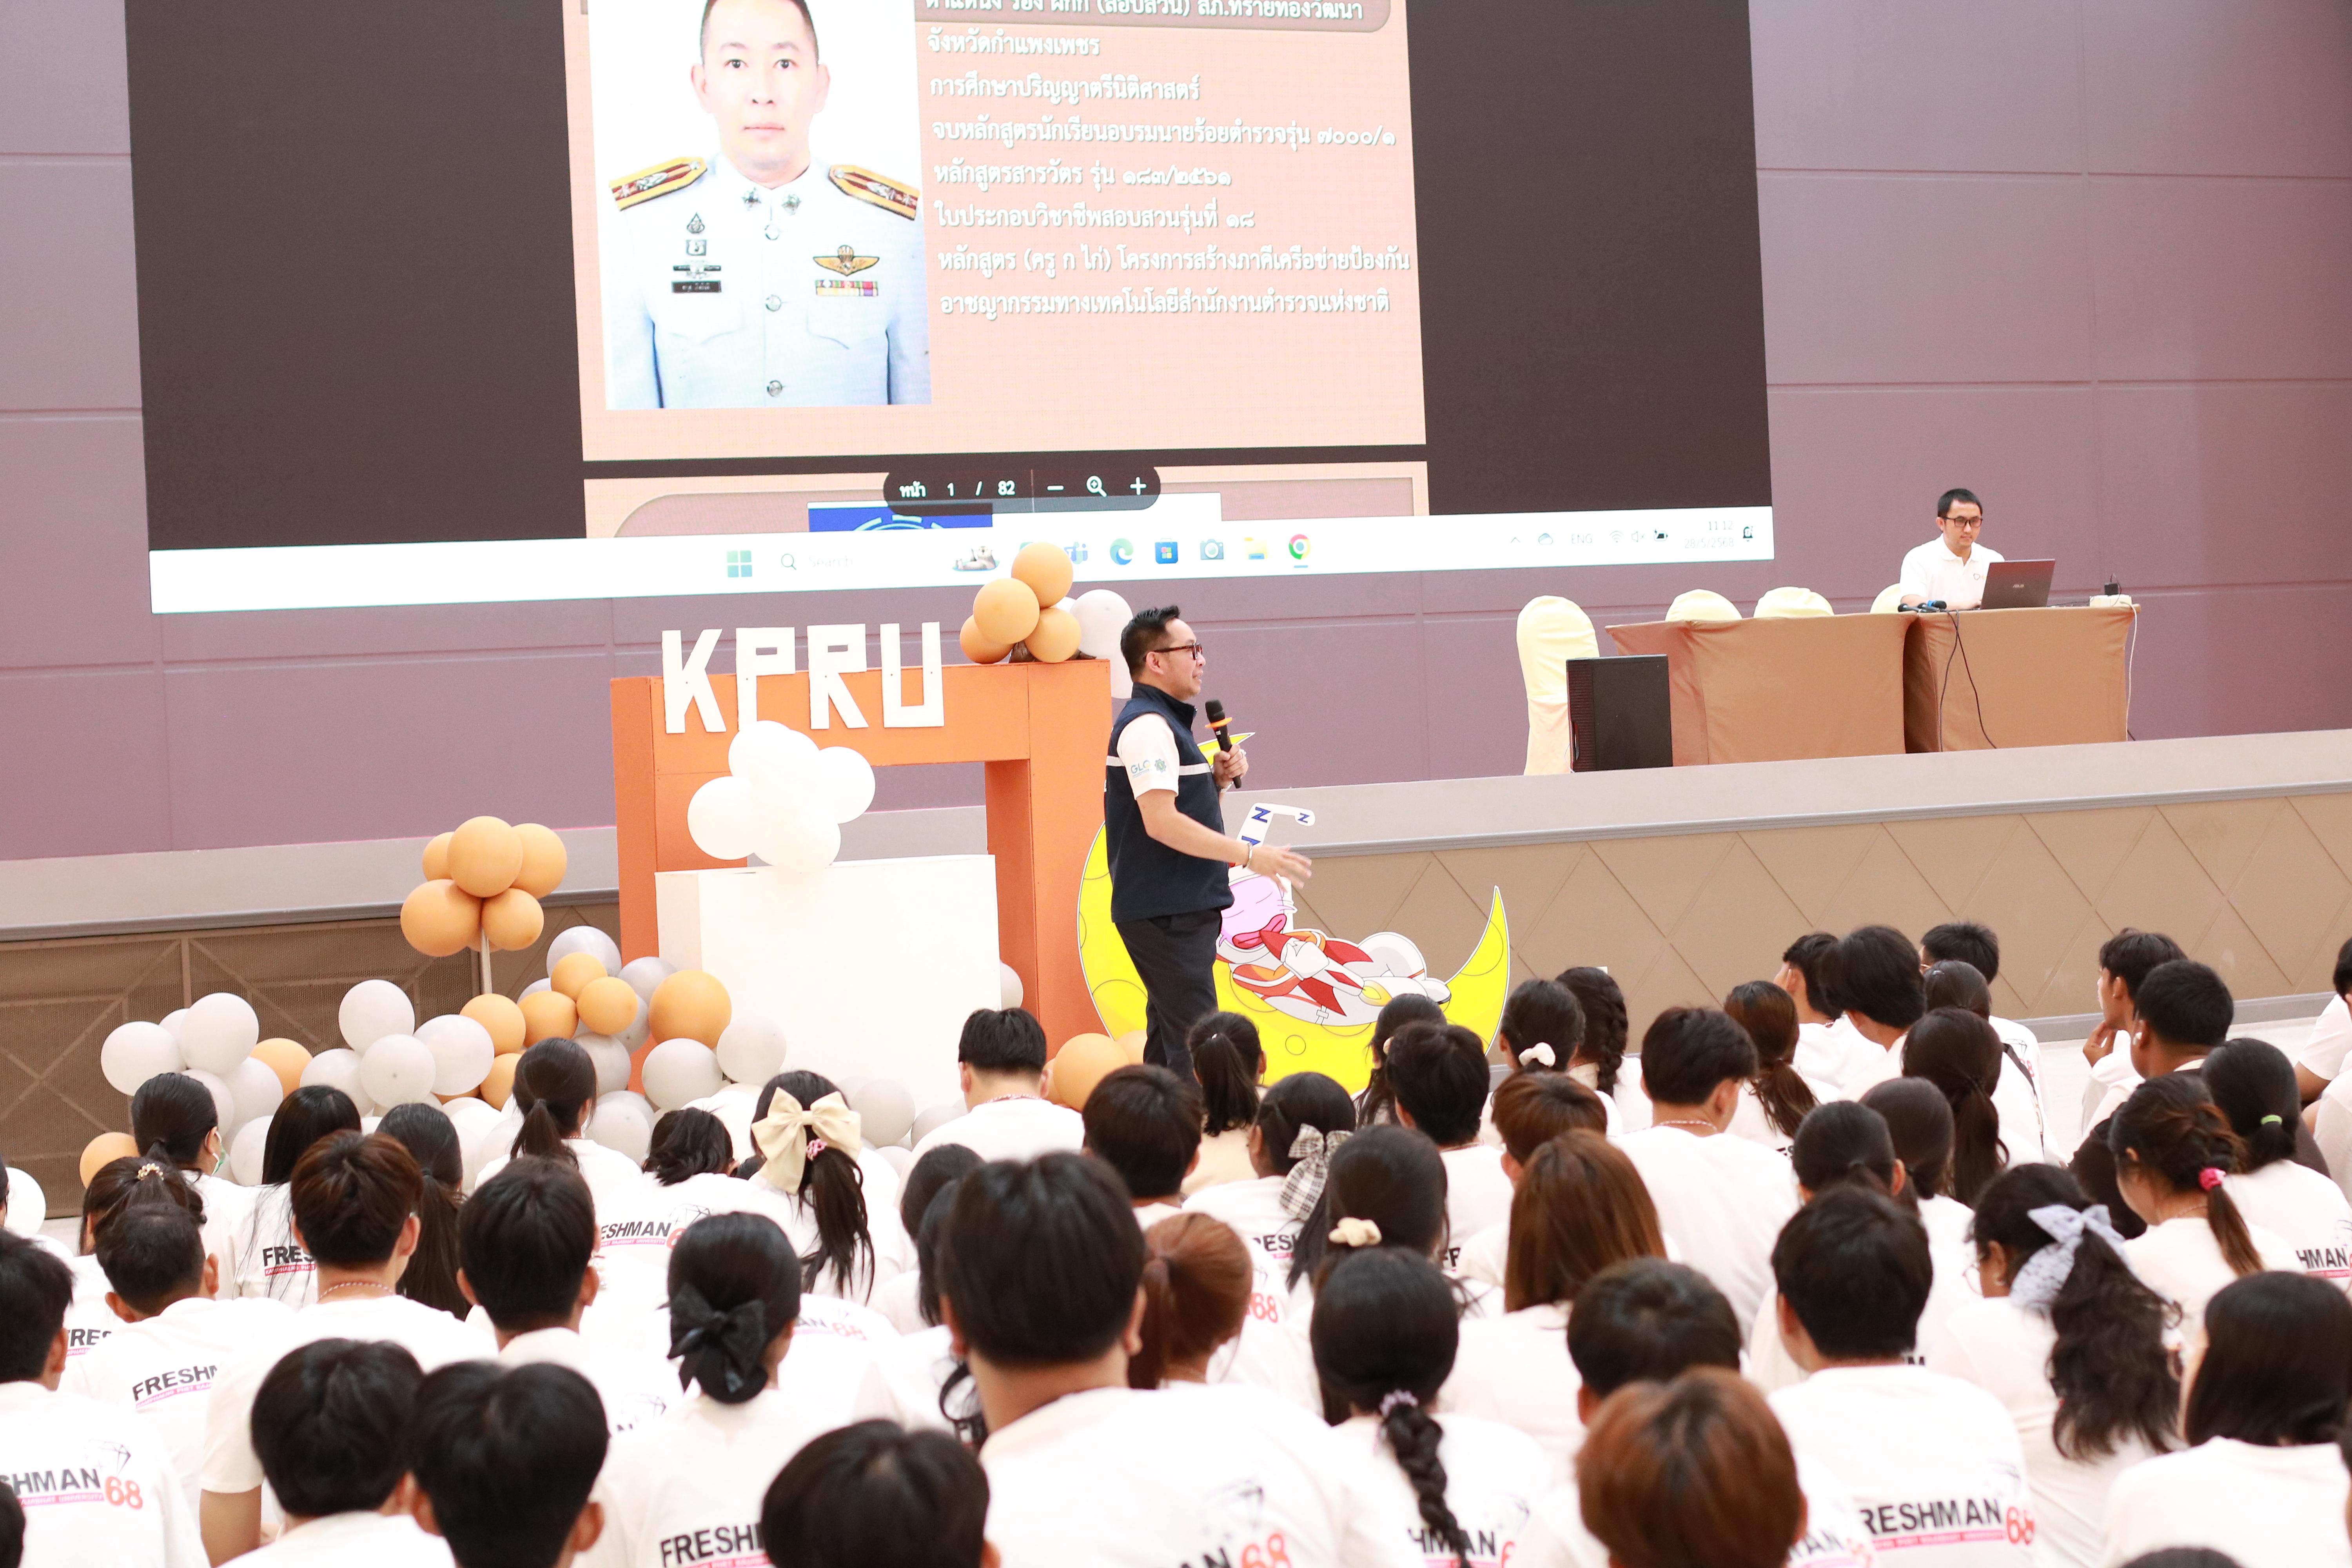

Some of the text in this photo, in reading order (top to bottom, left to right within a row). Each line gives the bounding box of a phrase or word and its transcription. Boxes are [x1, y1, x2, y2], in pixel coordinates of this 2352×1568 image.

[1198, 0, 1363, 19] สภ.ทรายทองวฒนา
[926, 26, 1100, 55] จังหวัดกำแพงเพชร
[930, 70, 1200, 104] การศึกษาปริญญาตรีนิติศาสตร์
[932, 113, 1310, 151] จบหลักสูตรนักเรียนอบรมนายร้อยตำรวจรุ่น
[933, 157, 1083, 192] หลักสูตรสารวัตร
[1090, 160, 1115, 192] รุ่น
[933, 197, 1255, 235] ใบประกอบวิชาชีพสอบสวนรุ่นที่ ๑๘
[938, 243, 1410, 279] หลักสูตร (ครู ก ไก่) โครงการสร้างภาคีเครือข่ายป้องกัน
[940, 287, 1390, 321] อาชญากรรมทางเทคโนโลยีสำนักงานตำรวจแห่งชาติ
[899, 480, 927, 498] หน้า
[947, 483, 954, 496] 1
[998, 479, 1015, 495] 82
[1571, 534, 1593, 544] ENG
[1709, 521, 1733, 530] 1112
[808, 555, 854, 568] Search
[662, 621, 944, 734] KPRU
[105, 1475, 143, 1510] 68
